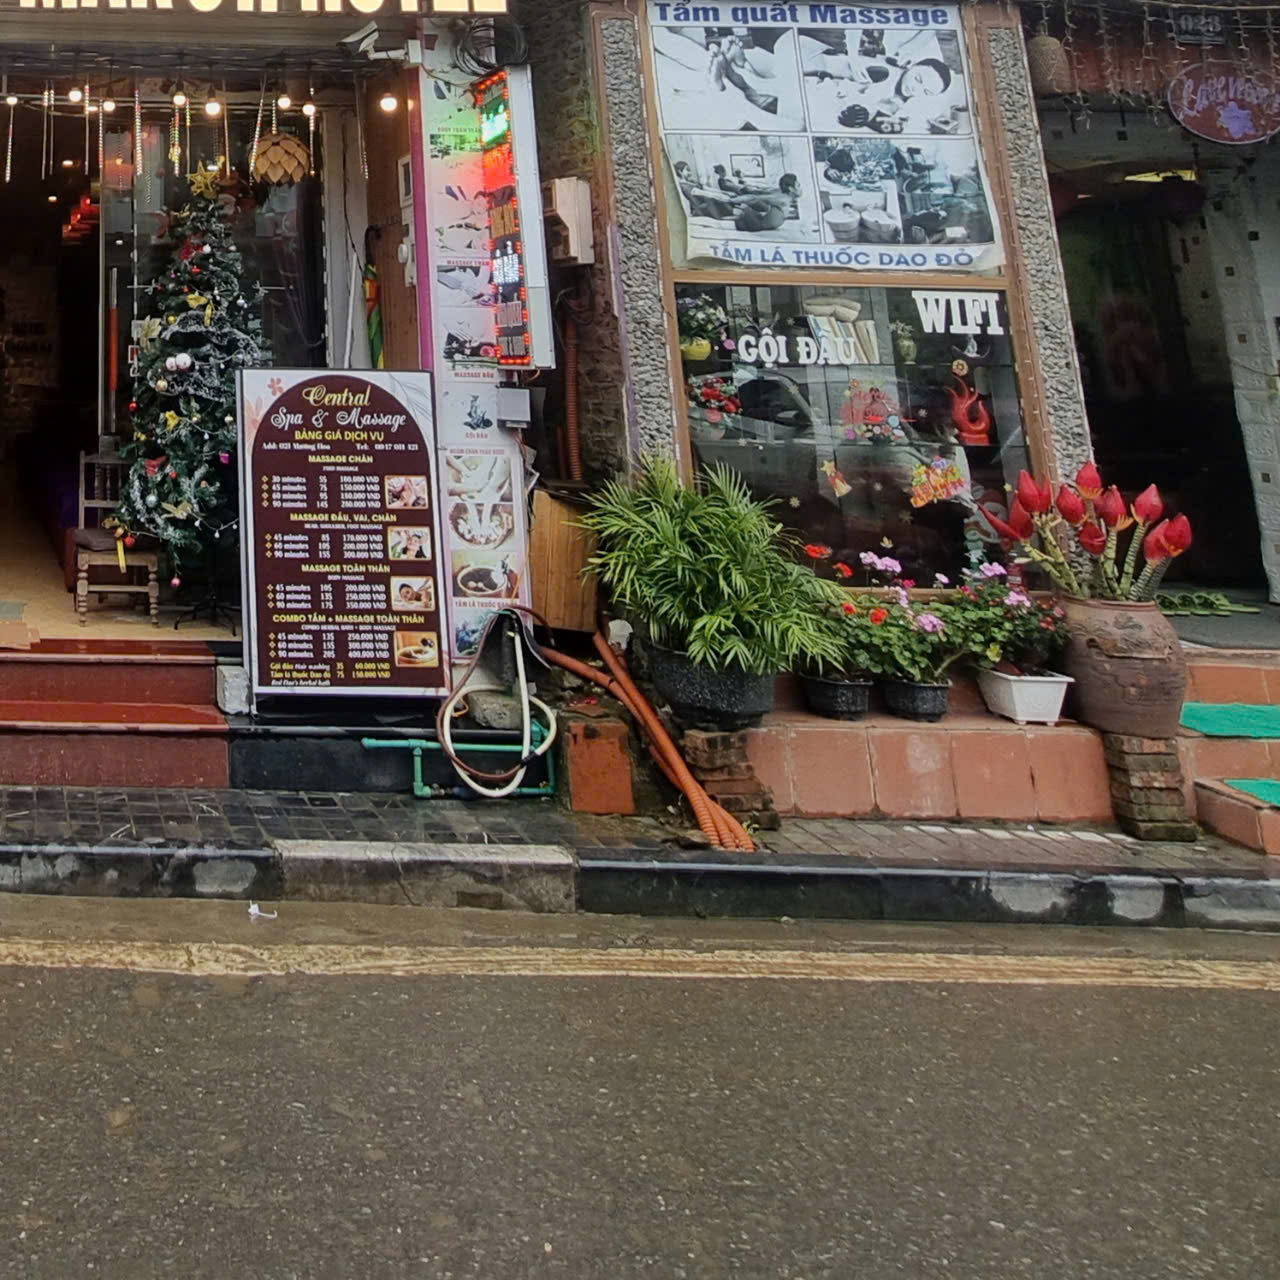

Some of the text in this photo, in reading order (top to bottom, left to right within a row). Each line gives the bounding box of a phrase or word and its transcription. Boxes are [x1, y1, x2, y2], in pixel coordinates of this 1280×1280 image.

[731, 0, 800, 26] quất
[809, 3, 949, 26] Massage
[709, 240, 754, 264] TẮM
[760, 244, 785, 265] LÁ
[792, 243, 872, 267] THUỐC
[879, 252, 928, 267] DAO
[911, 289, 1005, 336] WIFI
[737, 328, 858, 369] GỘI ĐẦU
[302, 384, 372, 407] Central
[270, 406, 407, 433] Spa & Massage
[325, 429, 342, 441] GIÁ
[308, 455, 347, 463] MASSAGE
[290, 513, 329, 521] MASSAGE
[301, 564, 340, 572] MASSAGE
[273, 614, 306, 623] COMBO
[335, 615, 374, 623] MASSAGE
